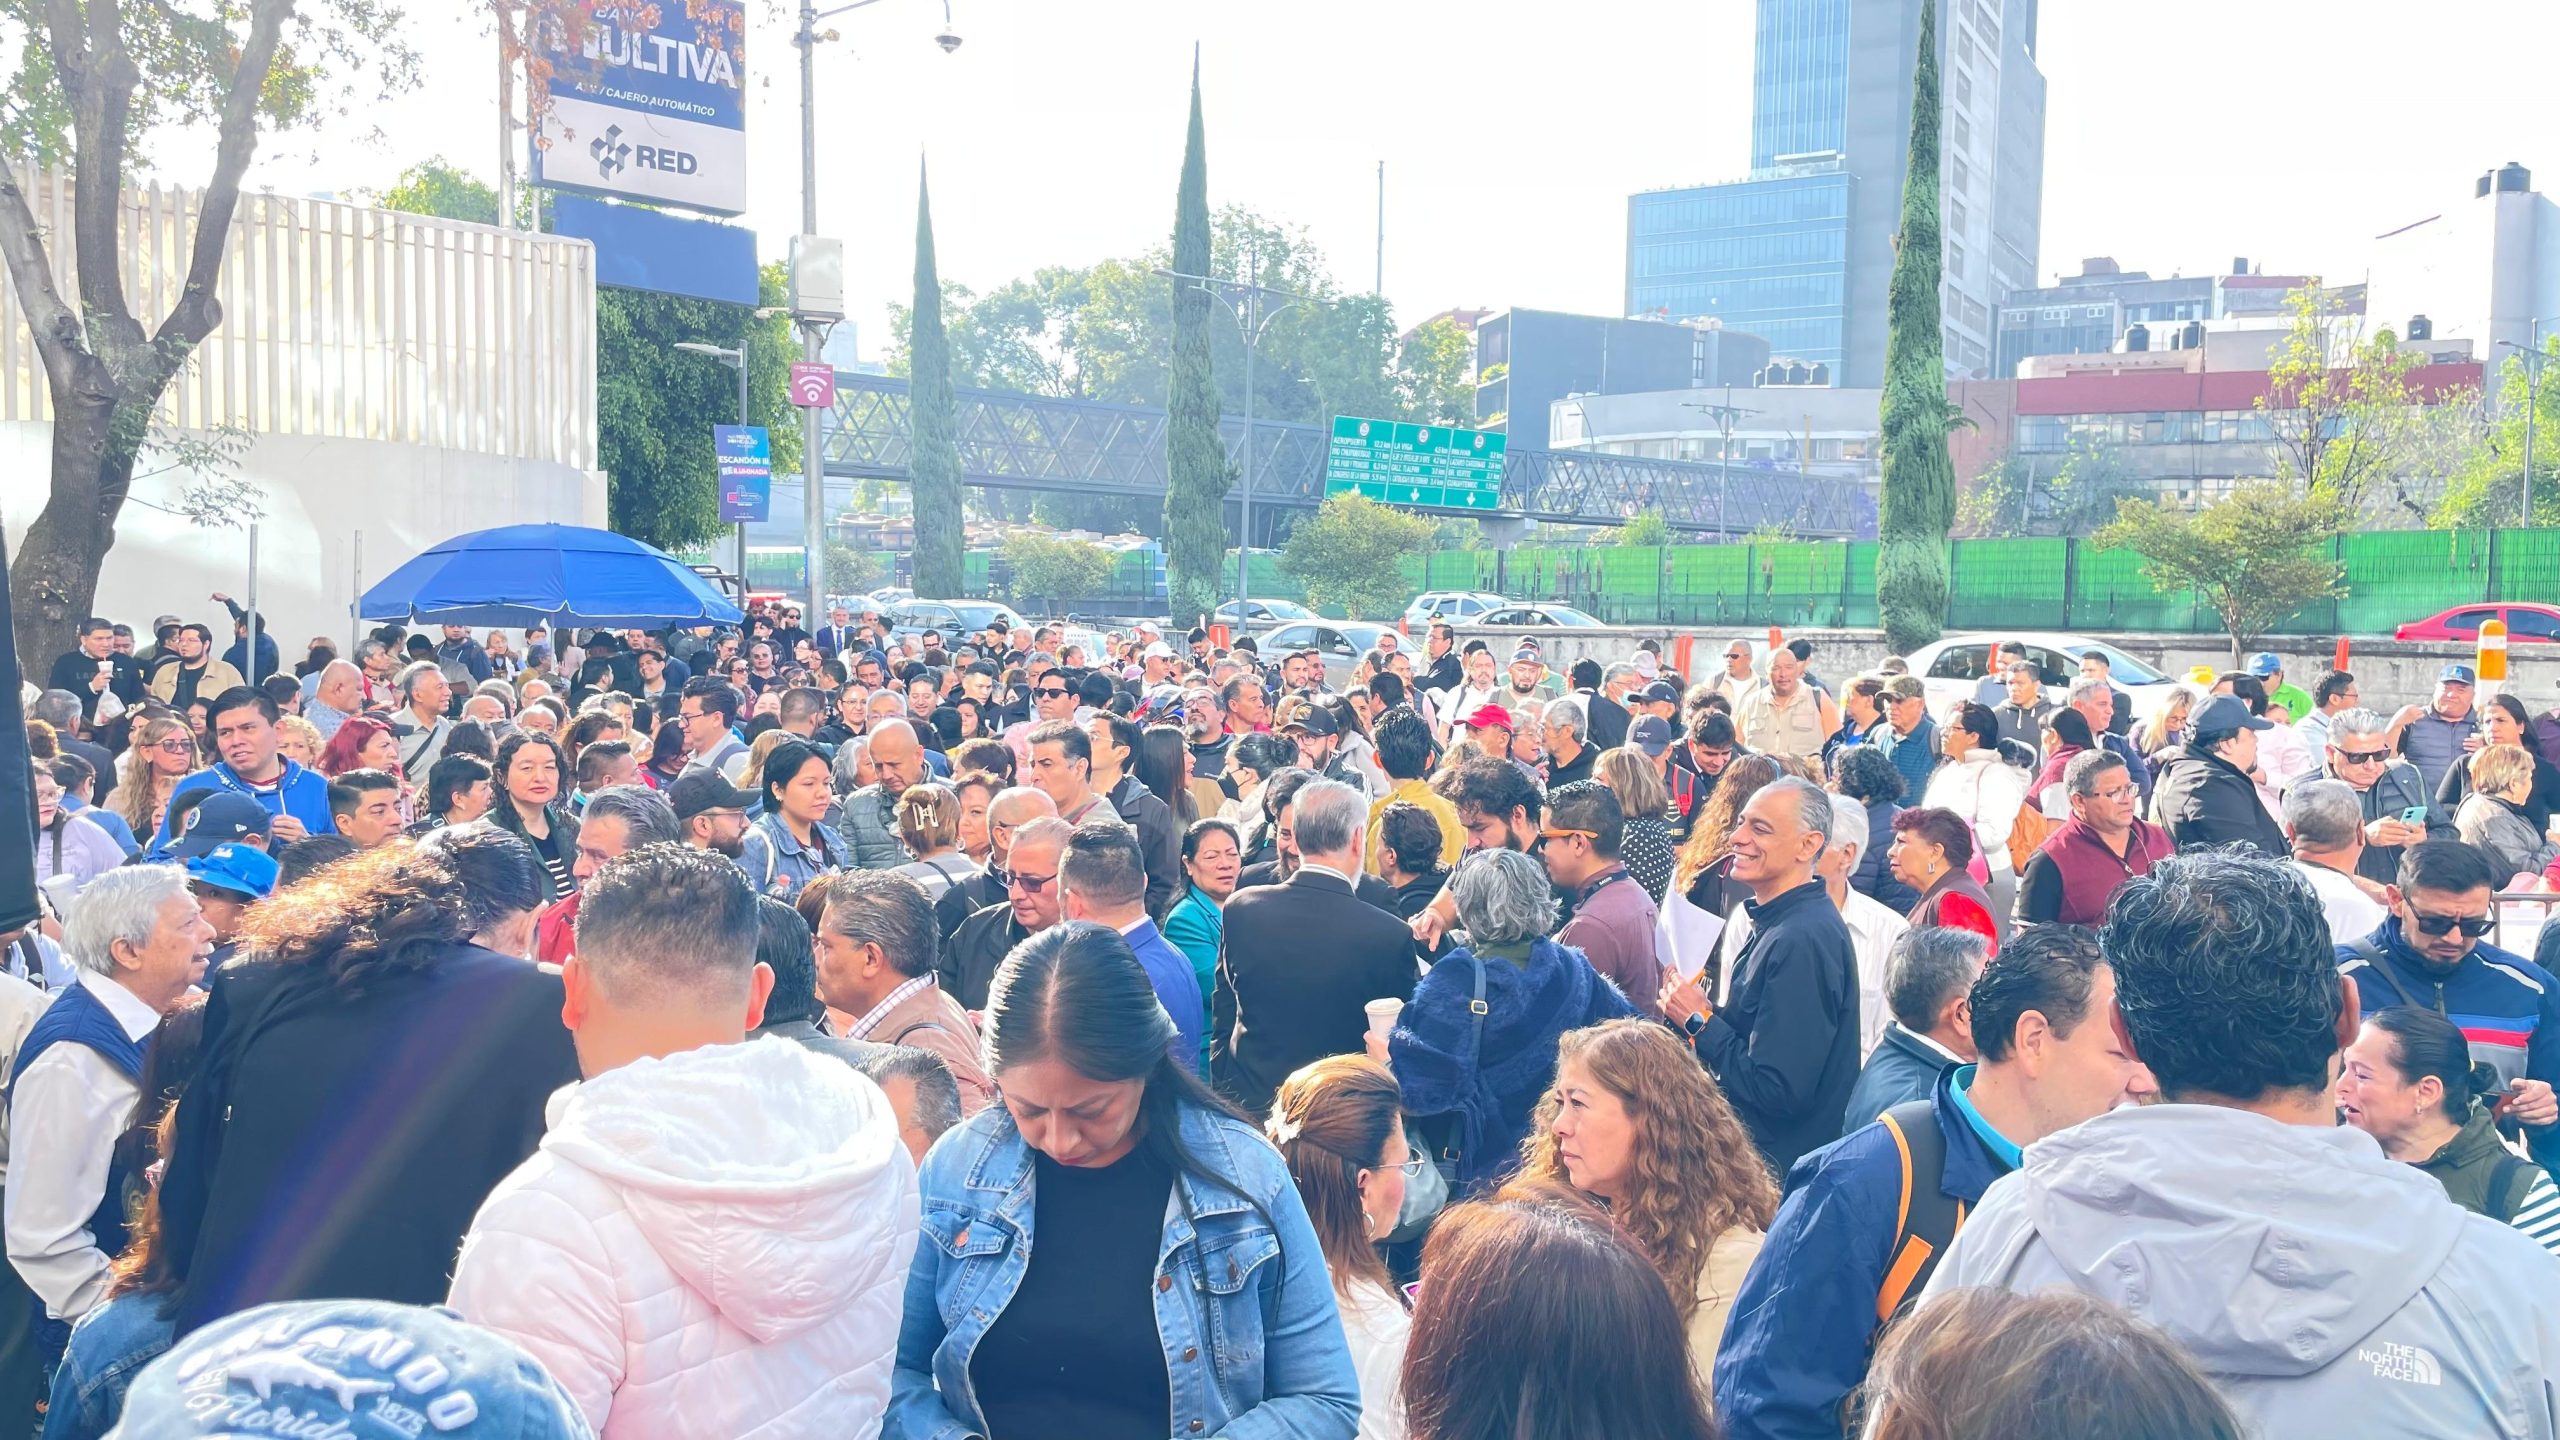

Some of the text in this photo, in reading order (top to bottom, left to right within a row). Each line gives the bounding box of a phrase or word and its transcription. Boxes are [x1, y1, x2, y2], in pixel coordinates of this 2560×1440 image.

[606, 87, 649, 104] CAJERO
[649, 96, 715, 117] AUTOMÁTICO
[636, 144, 698, 176] RED
[718, 455, 761, 465] ESCANDÓN
[2384, 1341, 2415, 1357] THE
[2358, 1349, 2414, 1370] NORTH
[2373, 1365, 2414, 1382] FACE
